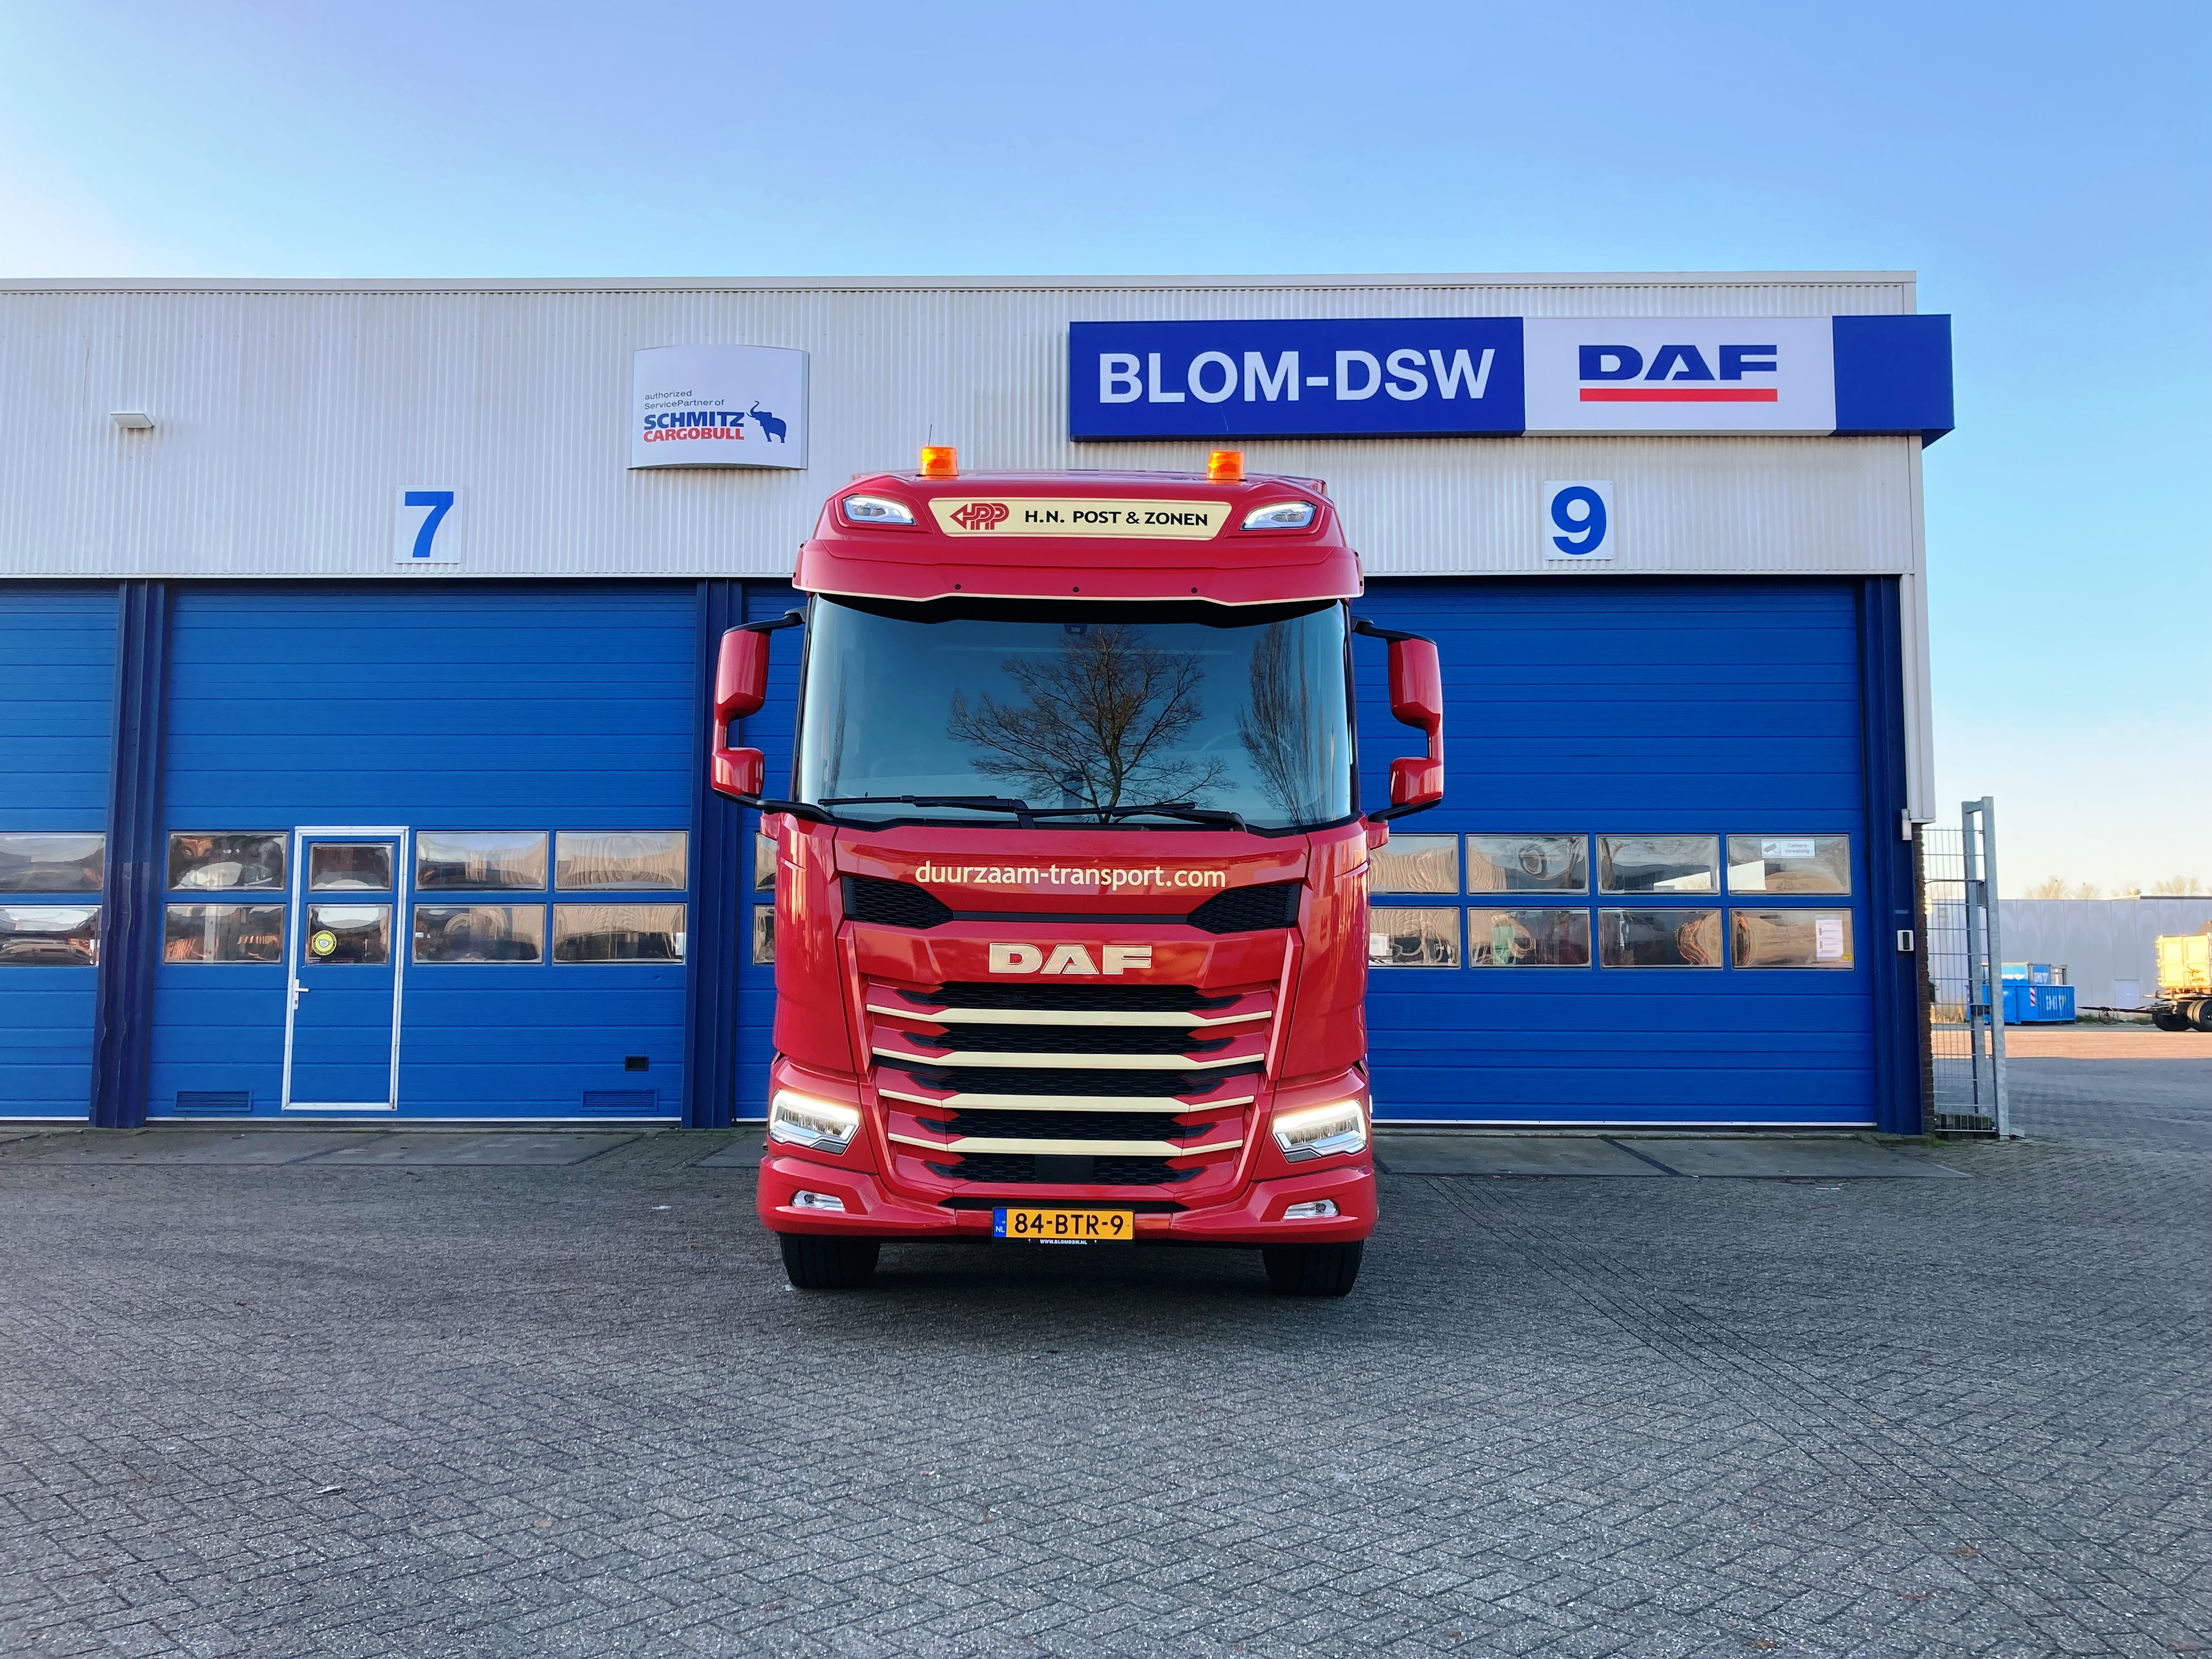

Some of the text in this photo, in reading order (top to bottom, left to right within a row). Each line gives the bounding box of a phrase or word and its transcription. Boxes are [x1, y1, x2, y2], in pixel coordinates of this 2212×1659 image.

[1099, 348, 1496, 404] BLOM-DSW
[1578, 345, 1778, 381] DAF
[644, 399, 713, 409] ServicePartner
[645, 390, 692, 400] authorized
[644, 411, 745, 430] SCHMITZ
[643, 427, 744, 443] CARGOBULL
[404, 491, 454, 558] 7
[1025, 510, 1207, 526] H.N. POST & ZONEN
[1551, 486, 1607, 555] 9
[915, 860, 1226, 891] duurzaam-transport.com
[989, 943, 1152, 975] DAF
[1014, 1213, 1124, 1235] 84-BTR-9
